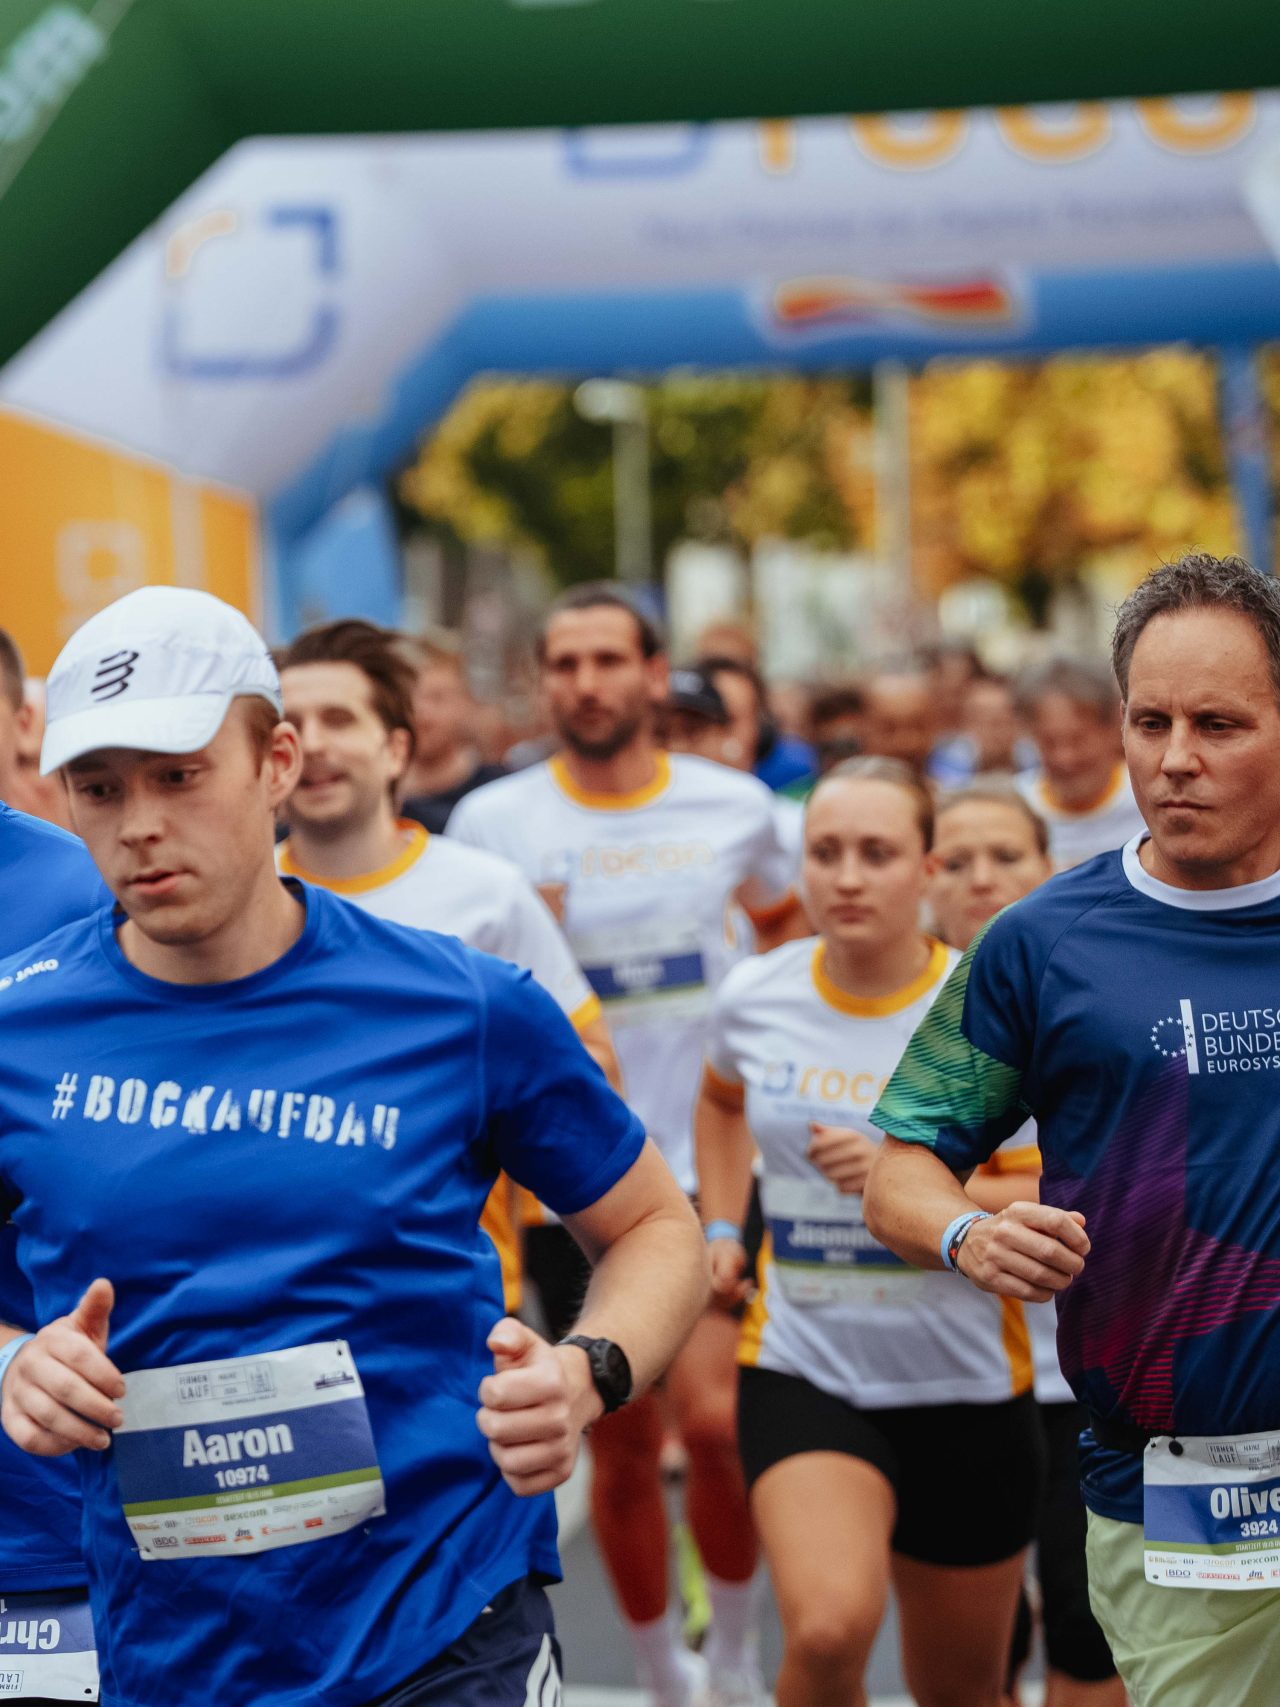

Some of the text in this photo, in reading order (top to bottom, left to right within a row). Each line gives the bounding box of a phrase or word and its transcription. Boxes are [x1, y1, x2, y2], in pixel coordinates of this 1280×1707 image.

[15, 959, 58, 982] JAKO
[1202, 1008, 1280, 1032] DEUTS
[800, 1066, 891, 1104] roc
[52, 1072, 400, 1150] #BOCKAUFBAU
[181, 1384, 210, 1400] LAUF
[183, 1423, 294, 1468] Aaron
[1209, 1445, 1234, 1453] FIRMEN
[1213, 1453, 1235, 1464] LAUF
[214, 1464, 270, 1488] 10974
[1240, 1519, 1278, 1537] 3924
[1168, 1569, 1191, 1577] BDO
